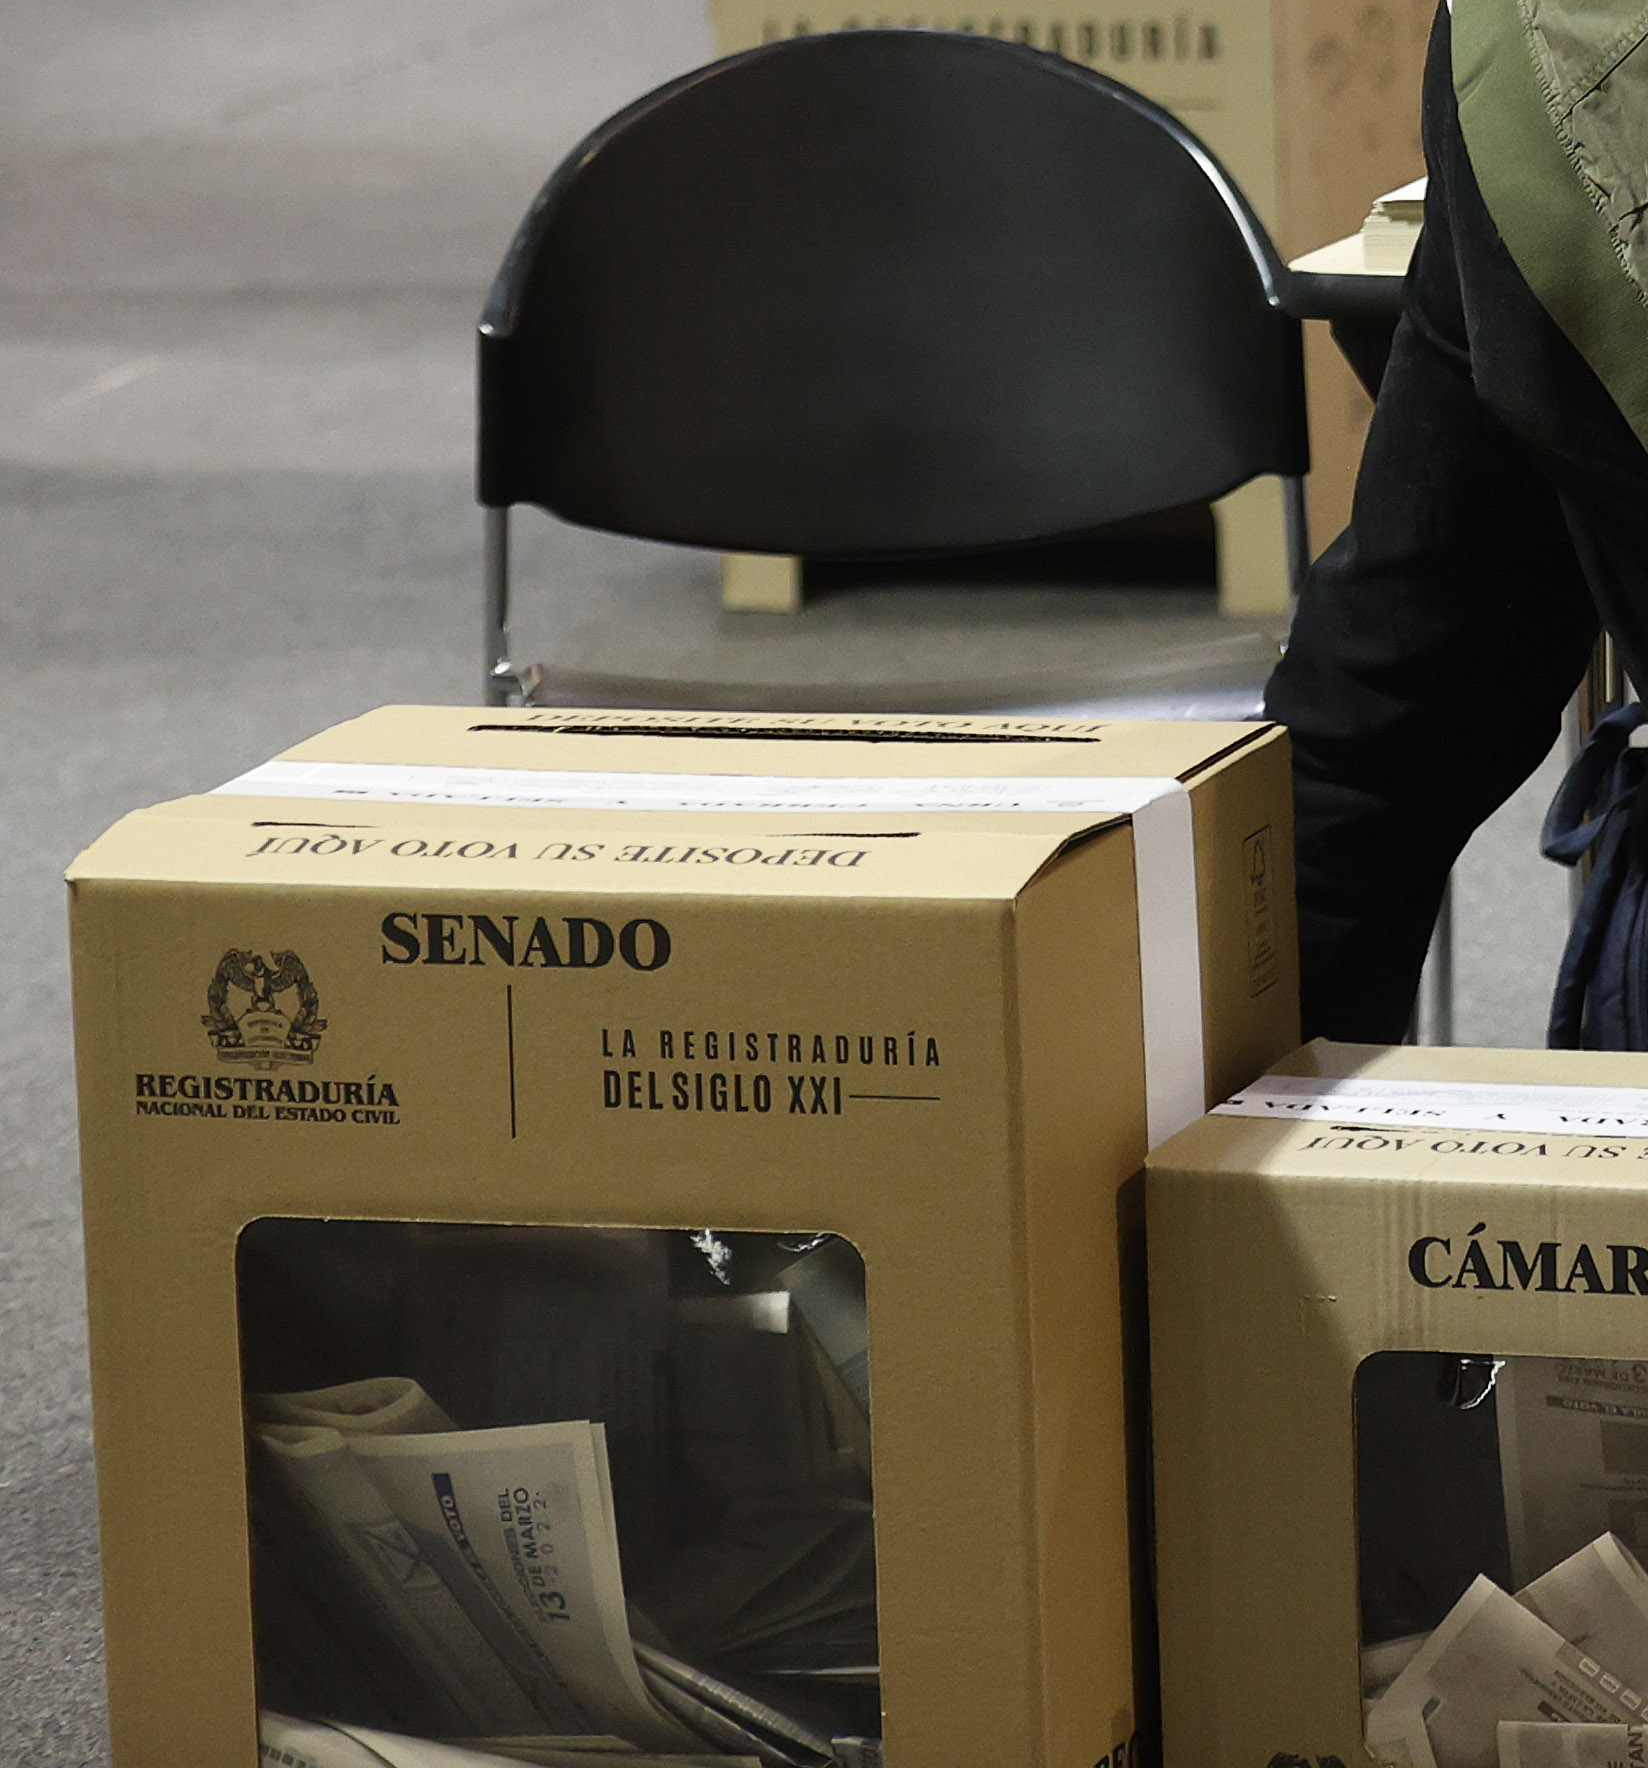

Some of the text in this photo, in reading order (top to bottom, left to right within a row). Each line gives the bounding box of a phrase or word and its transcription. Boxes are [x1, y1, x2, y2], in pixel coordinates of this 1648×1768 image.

[245, 834, 871, 868] DEPOSITE SU VOTO AQUÍ
[380, 911, 671, 971] SENADO
[601, 1027, 941, 1068] LA REGISTRADURÍA
[135, 1071, 400, 1108] REGISTRADURÍA
[603, 1070, 842, 1115] DEL SIGLO XXI
[136, 1101, 401, 1125] NACIONAL DEL ESTADO CIVIL
[1263, 1101, 1446, 1118] SELLADA
[1484, 1112, 1509, 1121] Y
[1302, 1133, 1420, 1155] AQUÍ
[1432, 1136, 1548, 1158] VOTO
[1564, 1141, 1625, 1160] SU
[496, 1487, 513, 1523] DEL
[513, 1487, 570, 1622] 13 DE MARZO
